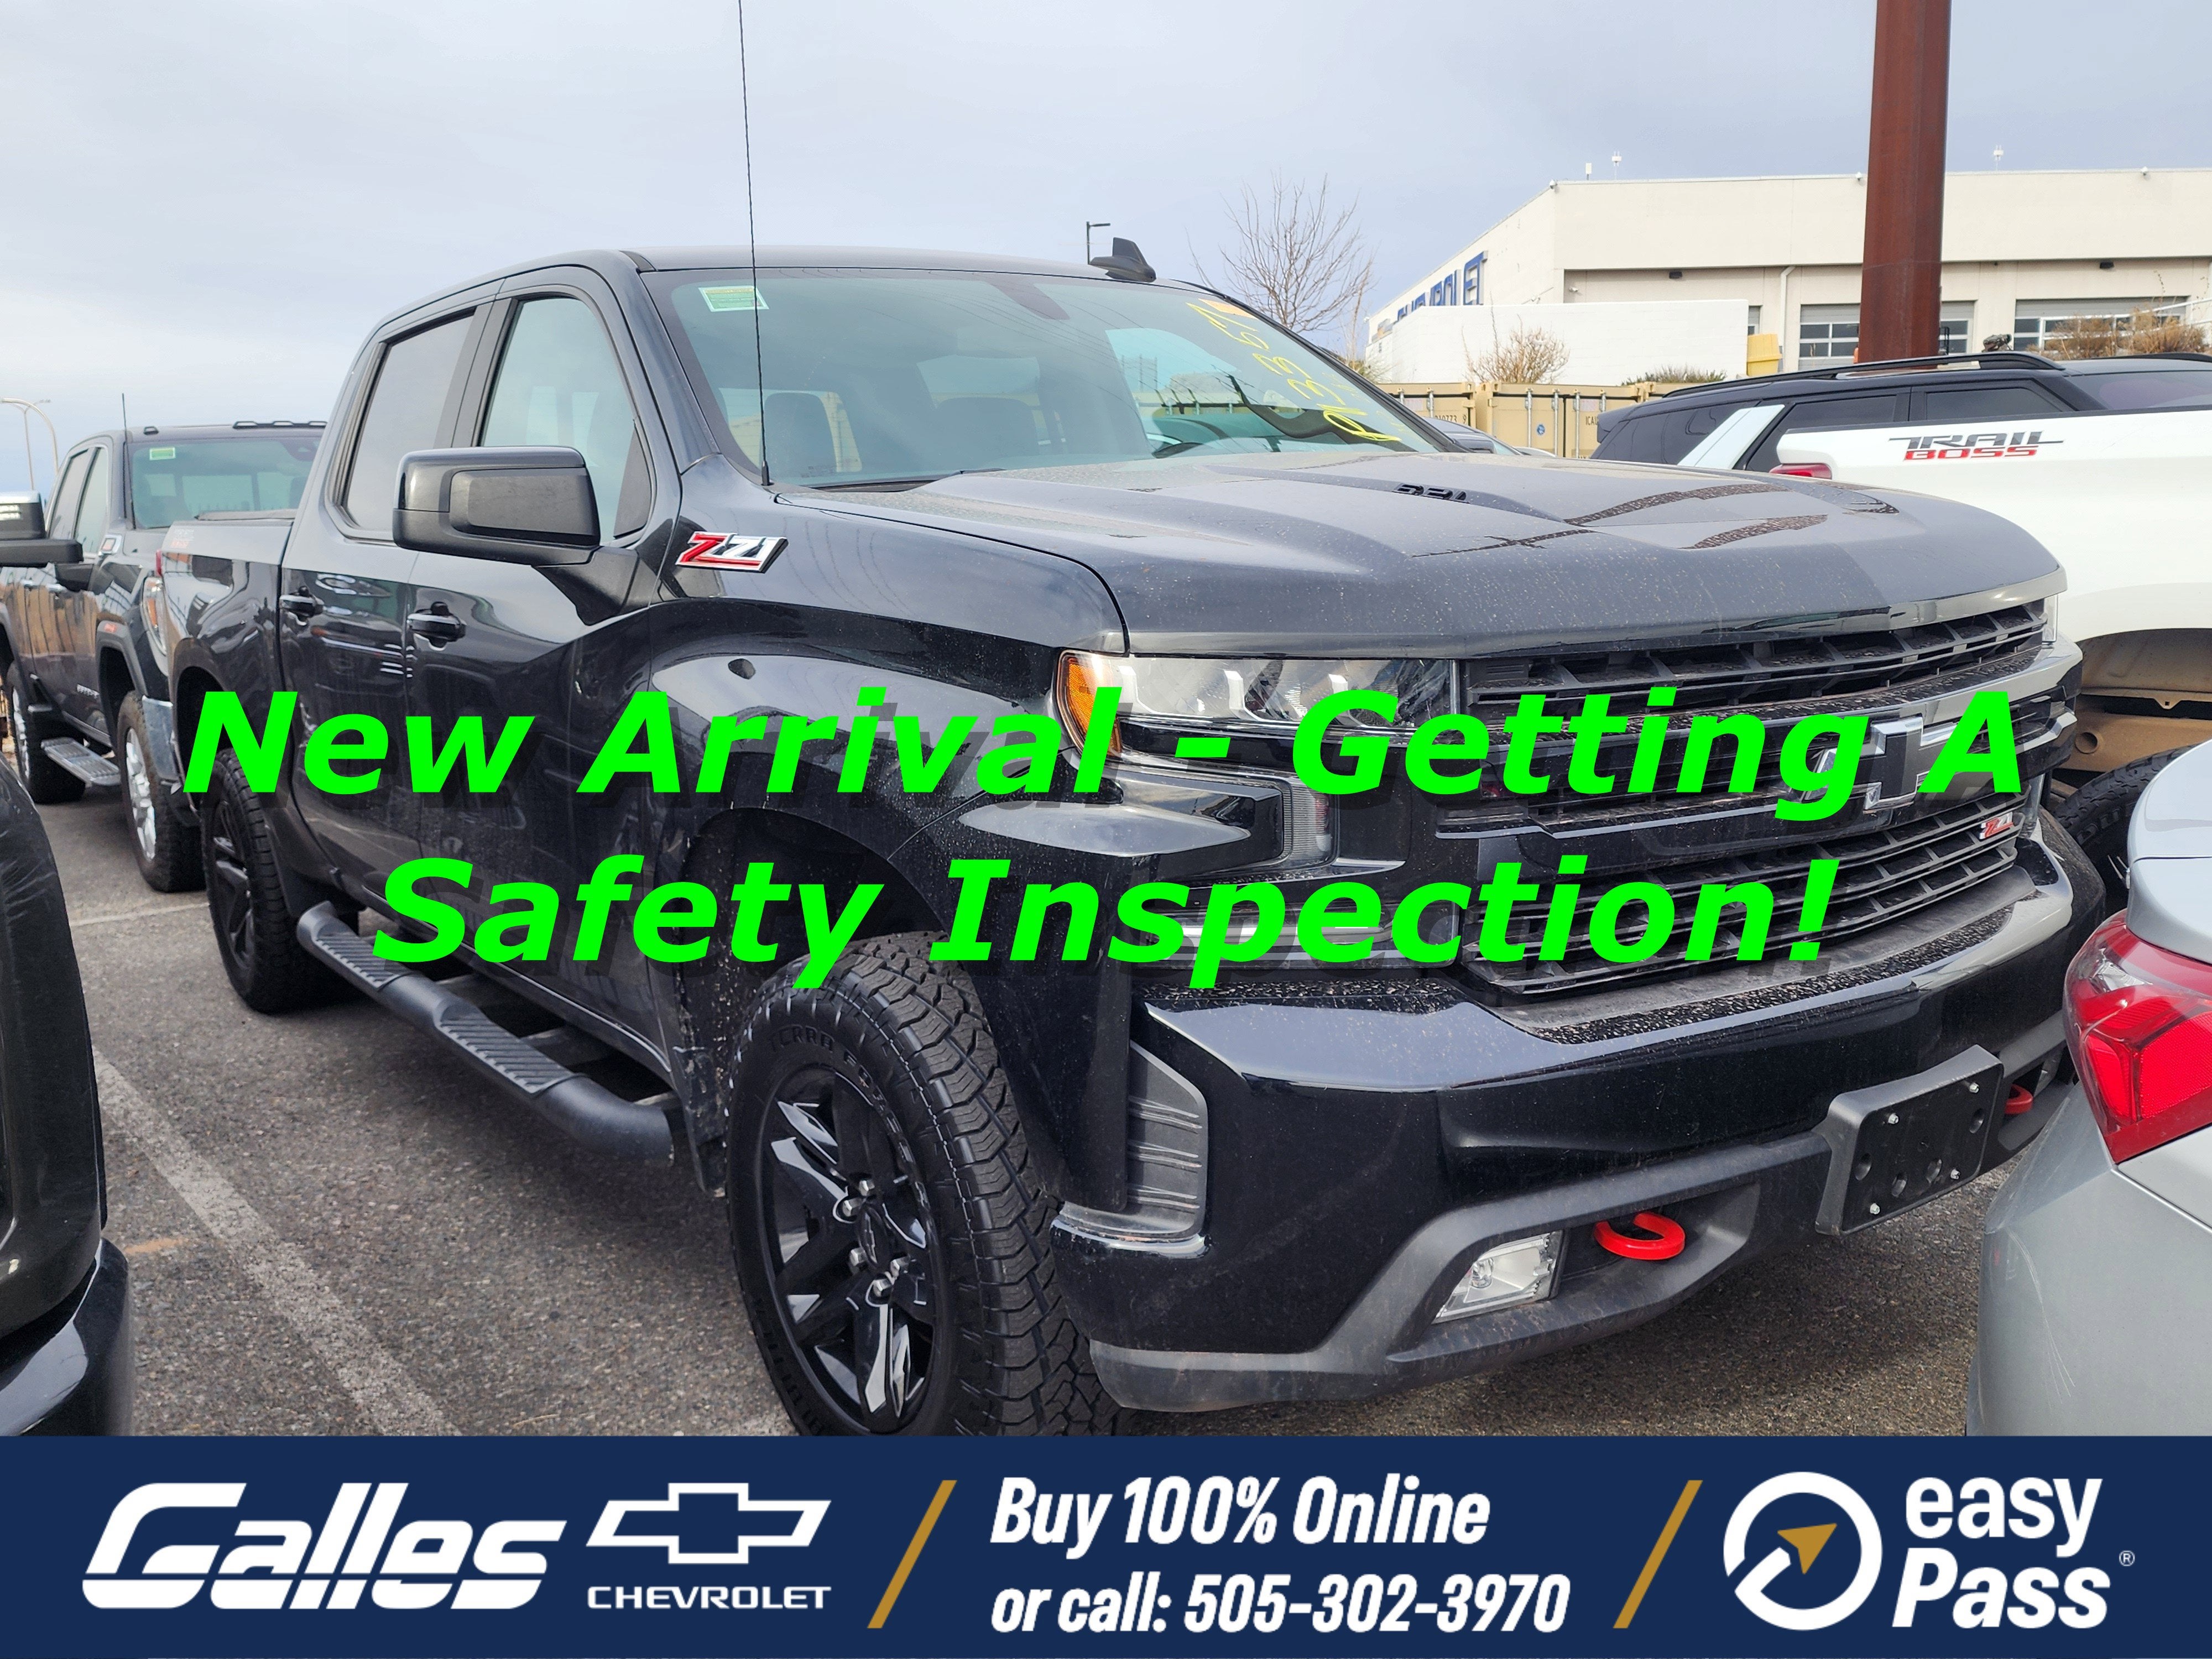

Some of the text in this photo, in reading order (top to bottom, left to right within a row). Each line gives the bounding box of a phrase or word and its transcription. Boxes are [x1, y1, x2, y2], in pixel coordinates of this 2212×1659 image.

[1888, 431, 2064, 450] TRAIL
[1903, 445, 2039, 461] BOSS
[675, 531, 789, 574] Z71
